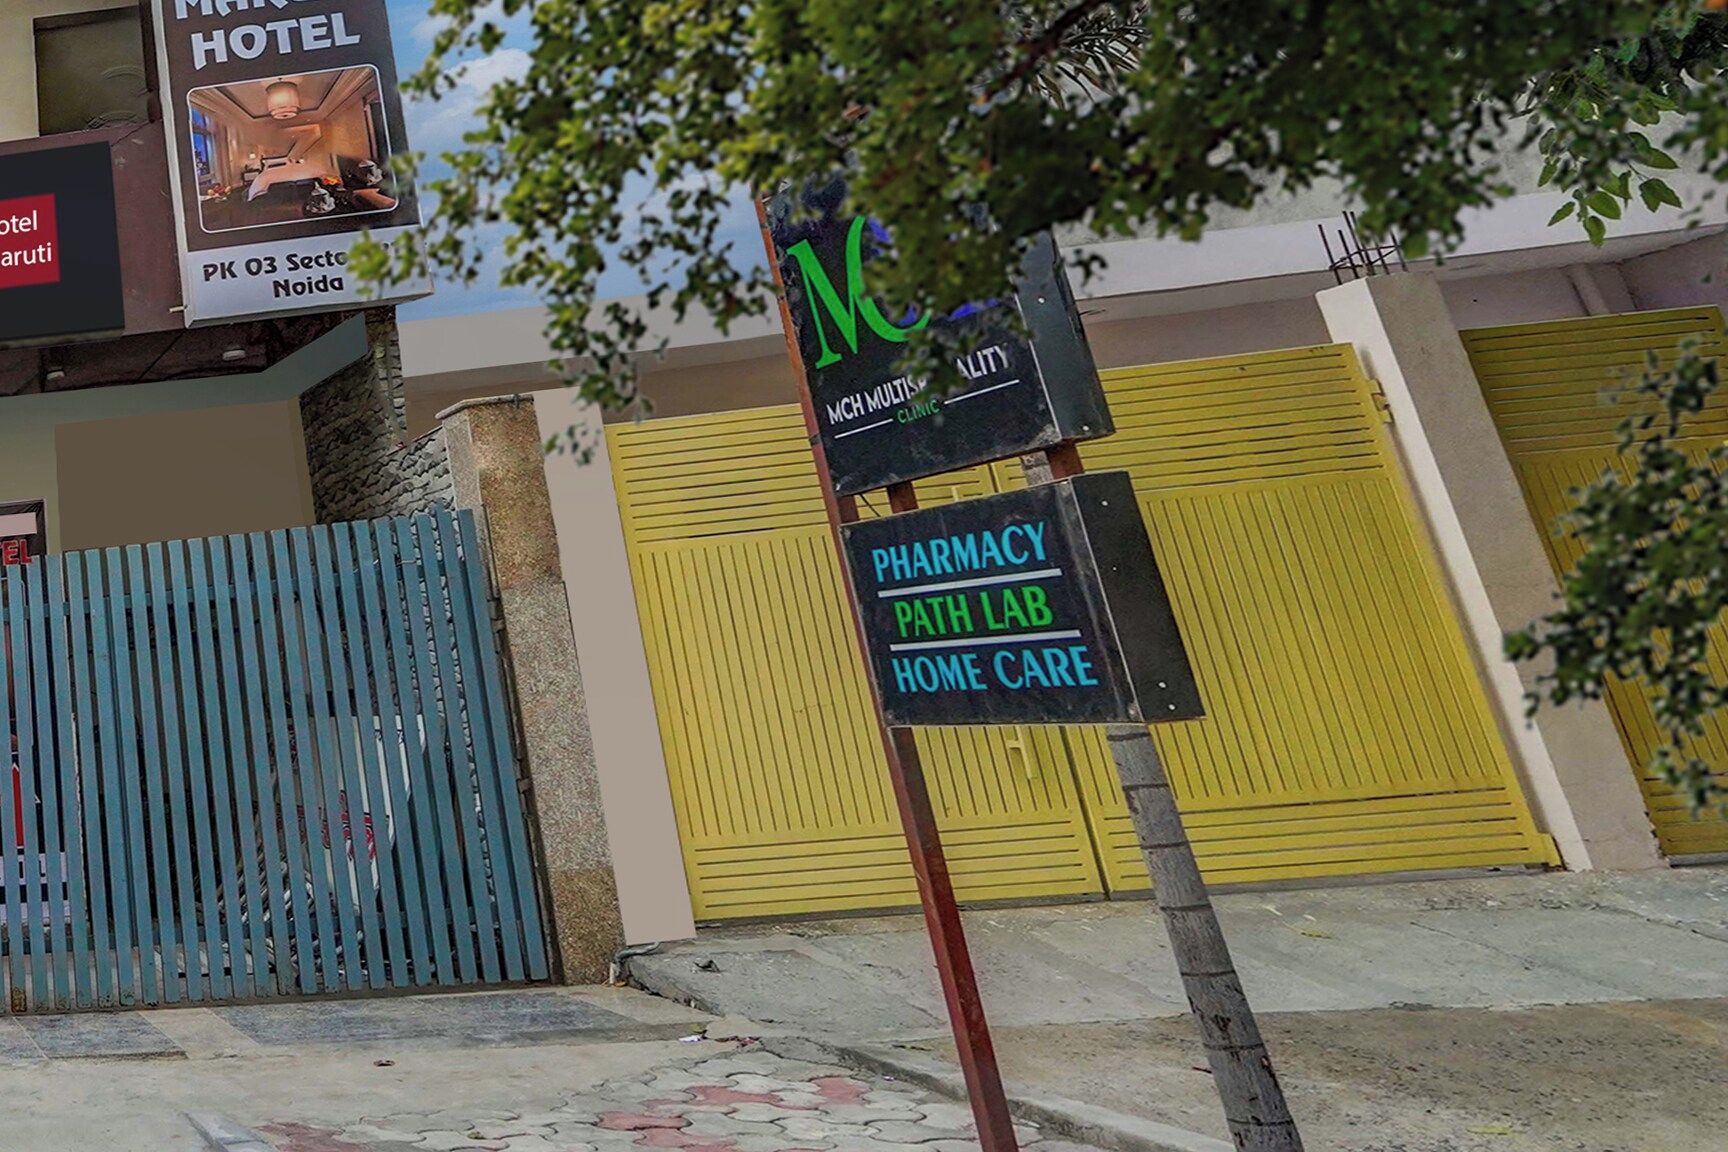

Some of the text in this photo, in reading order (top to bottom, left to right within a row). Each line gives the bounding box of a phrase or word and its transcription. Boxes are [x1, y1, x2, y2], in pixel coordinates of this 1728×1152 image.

[190, 12, 361, 71] HOTEL
[203, 260, 238, 282] PK
[245, 255, 277, 276] 03
[286, 250, 350, 272] Secto
[273, 274, 345, 298] Noida
[826, 394, 864, 425] MCH
[897, 399, 941, 424] CLINIC
[872, 521, 1047, 583] PHARMACY
[894, 585, 1054, 638] PATH LAB
[892, 645, 1099, 694] HOME CARE
